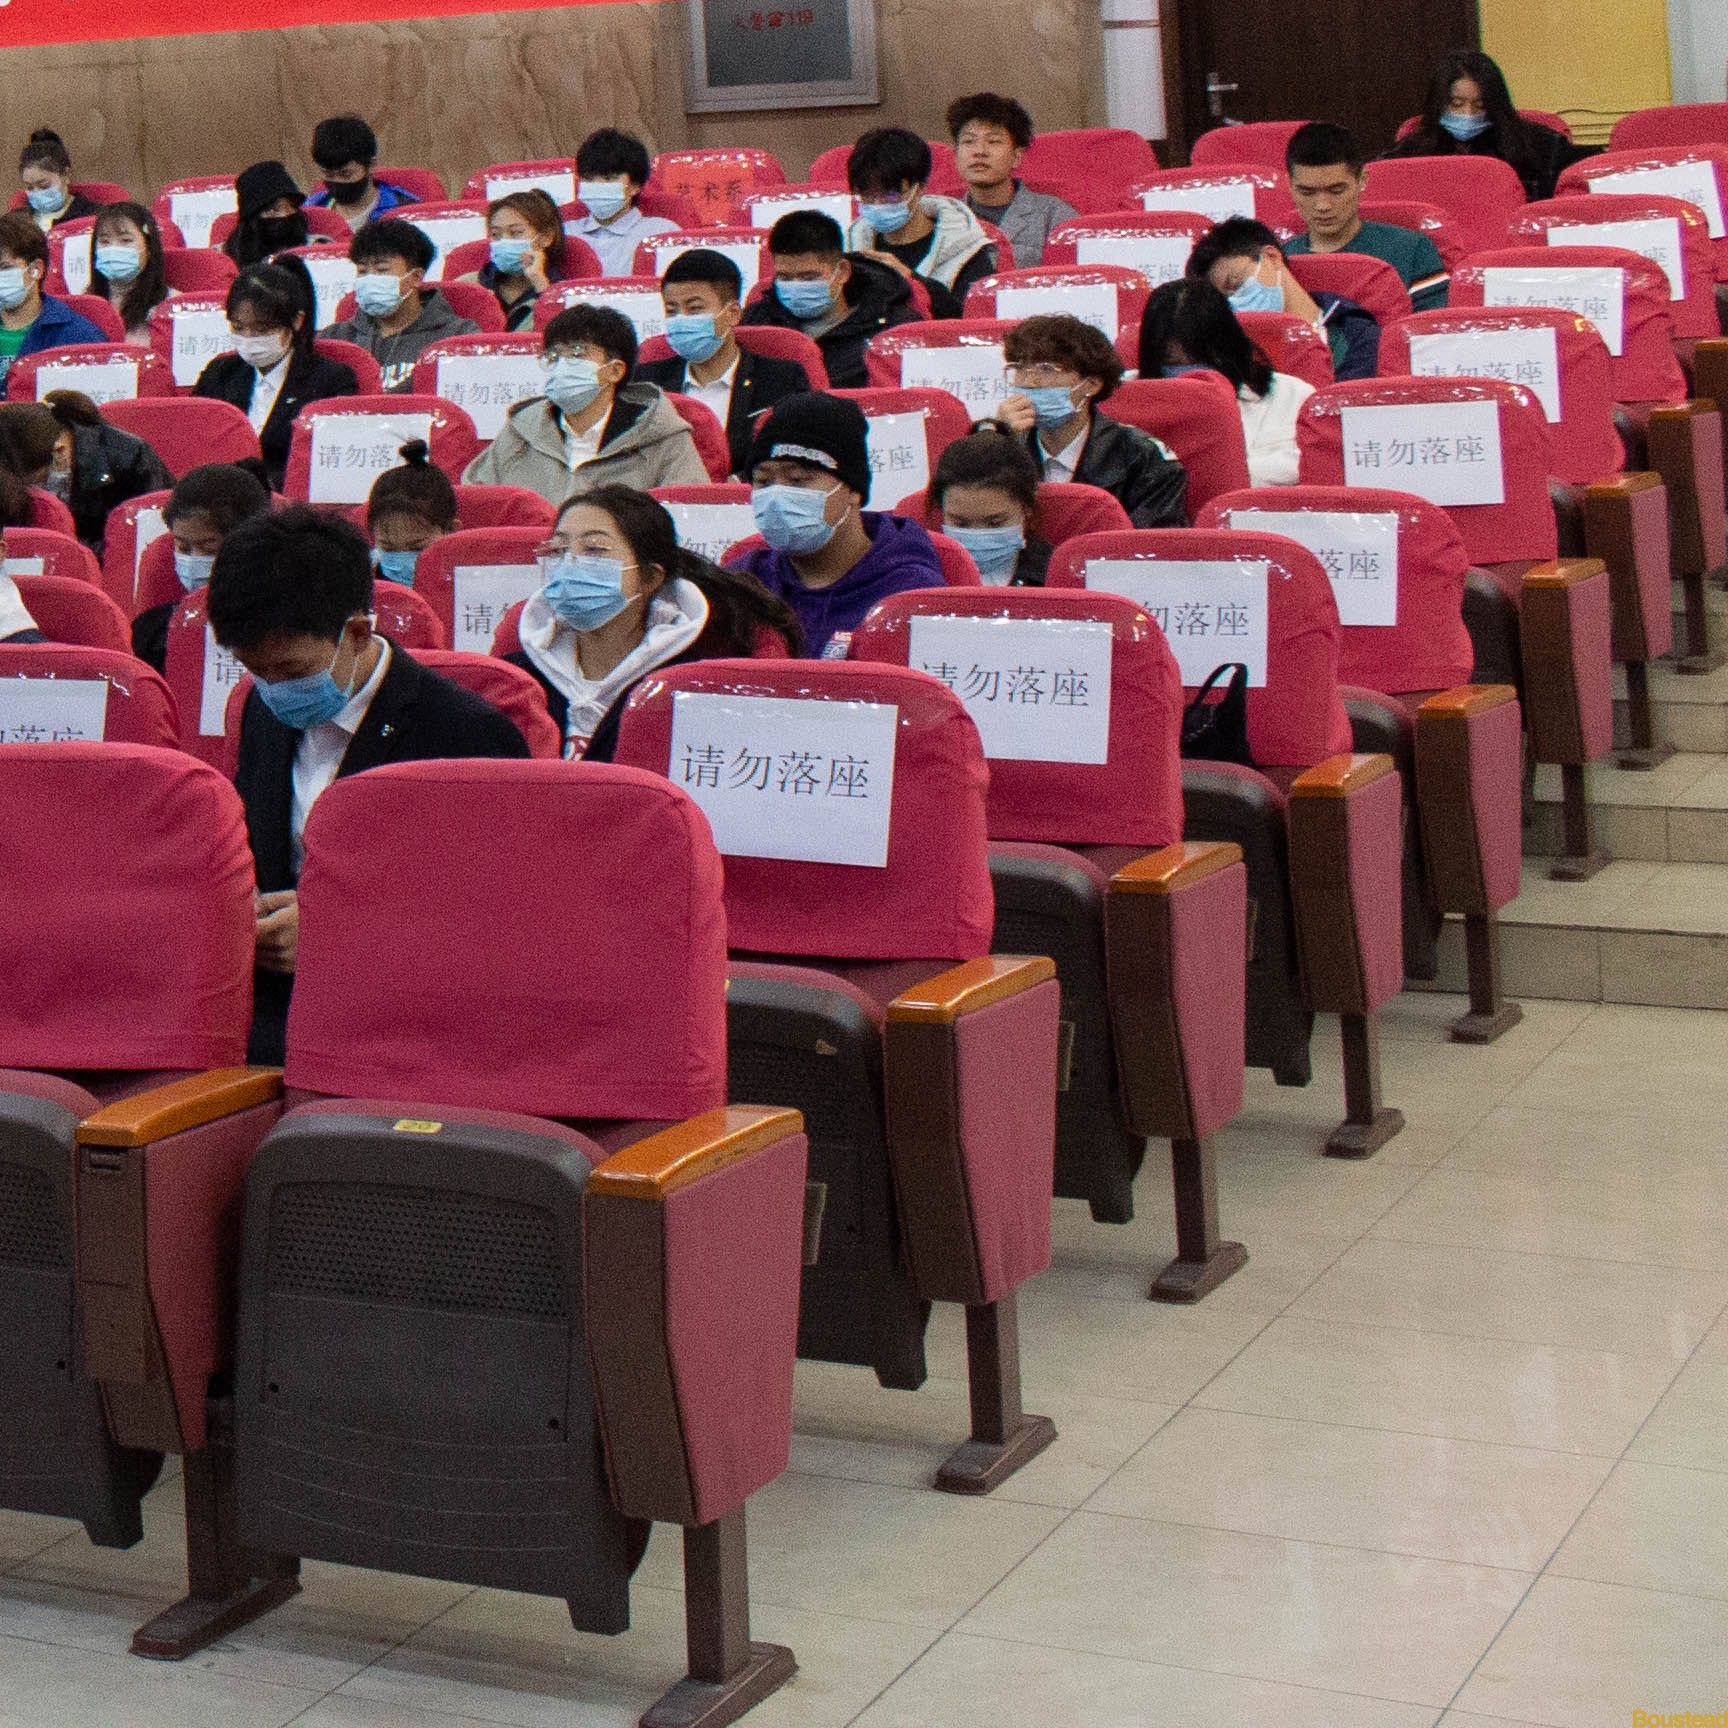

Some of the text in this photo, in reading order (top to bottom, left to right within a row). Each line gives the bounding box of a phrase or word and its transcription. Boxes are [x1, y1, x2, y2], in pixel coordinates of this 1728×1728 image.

[675, 179, 744, 203] 艺术系
[319, 444, 394, 469] 请勿落
[1352, 436, 1485, 469] 请勿落座
[1318, 548, 1380, 581] 落座
[1144, 602, 1249, 638] 勿落座
[681, 744, 871, 800] 请勿落座
